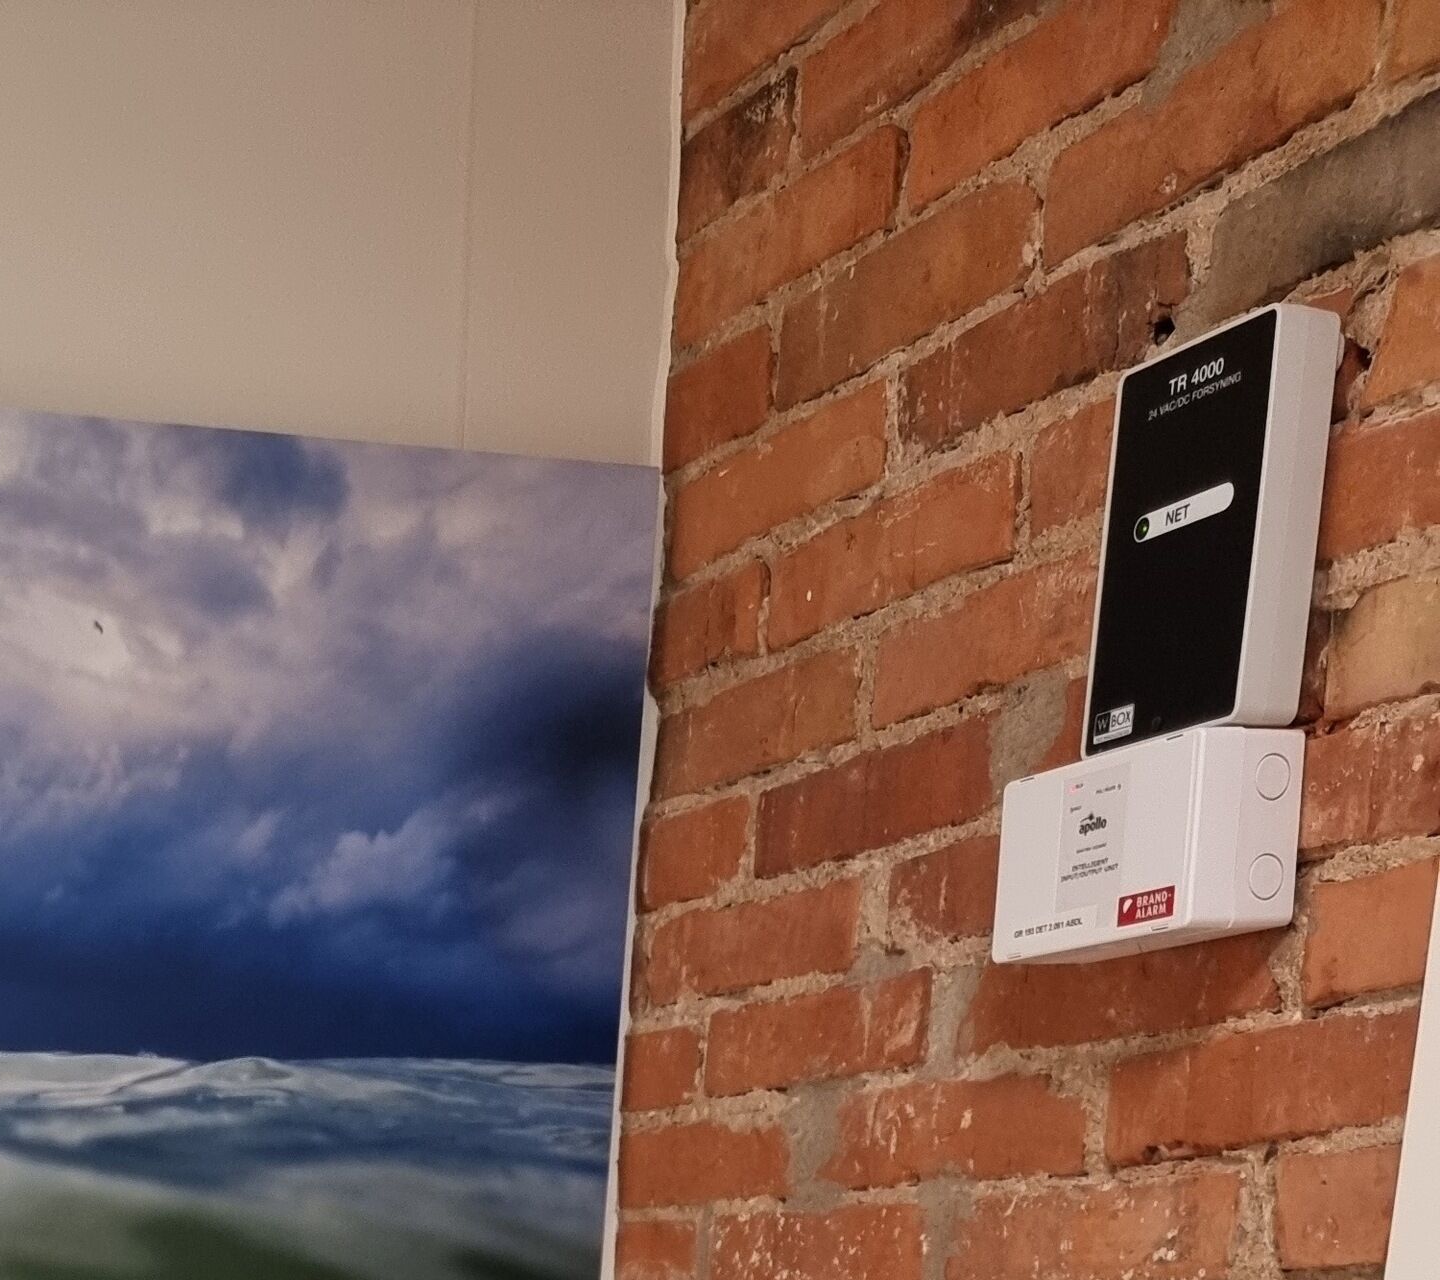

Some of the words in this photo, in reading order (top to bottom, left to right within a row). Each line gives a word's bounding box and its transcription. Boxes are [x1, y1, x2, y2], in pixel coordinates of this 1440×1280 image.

[1168, 373, 1188, 396] TR
[1190, 357, 1225, 386] 4000
[1159, 393, 1191, 416] VAC/DC
[1191, 371, 1242, 401] FORSYNING
[1164, 503, 1191, 527] NET
[1078, 815, 1107, 836] apollo
[1136, 890, 1172, 908] BRAND-
[1135, 902, 1167, 920] ALARM
